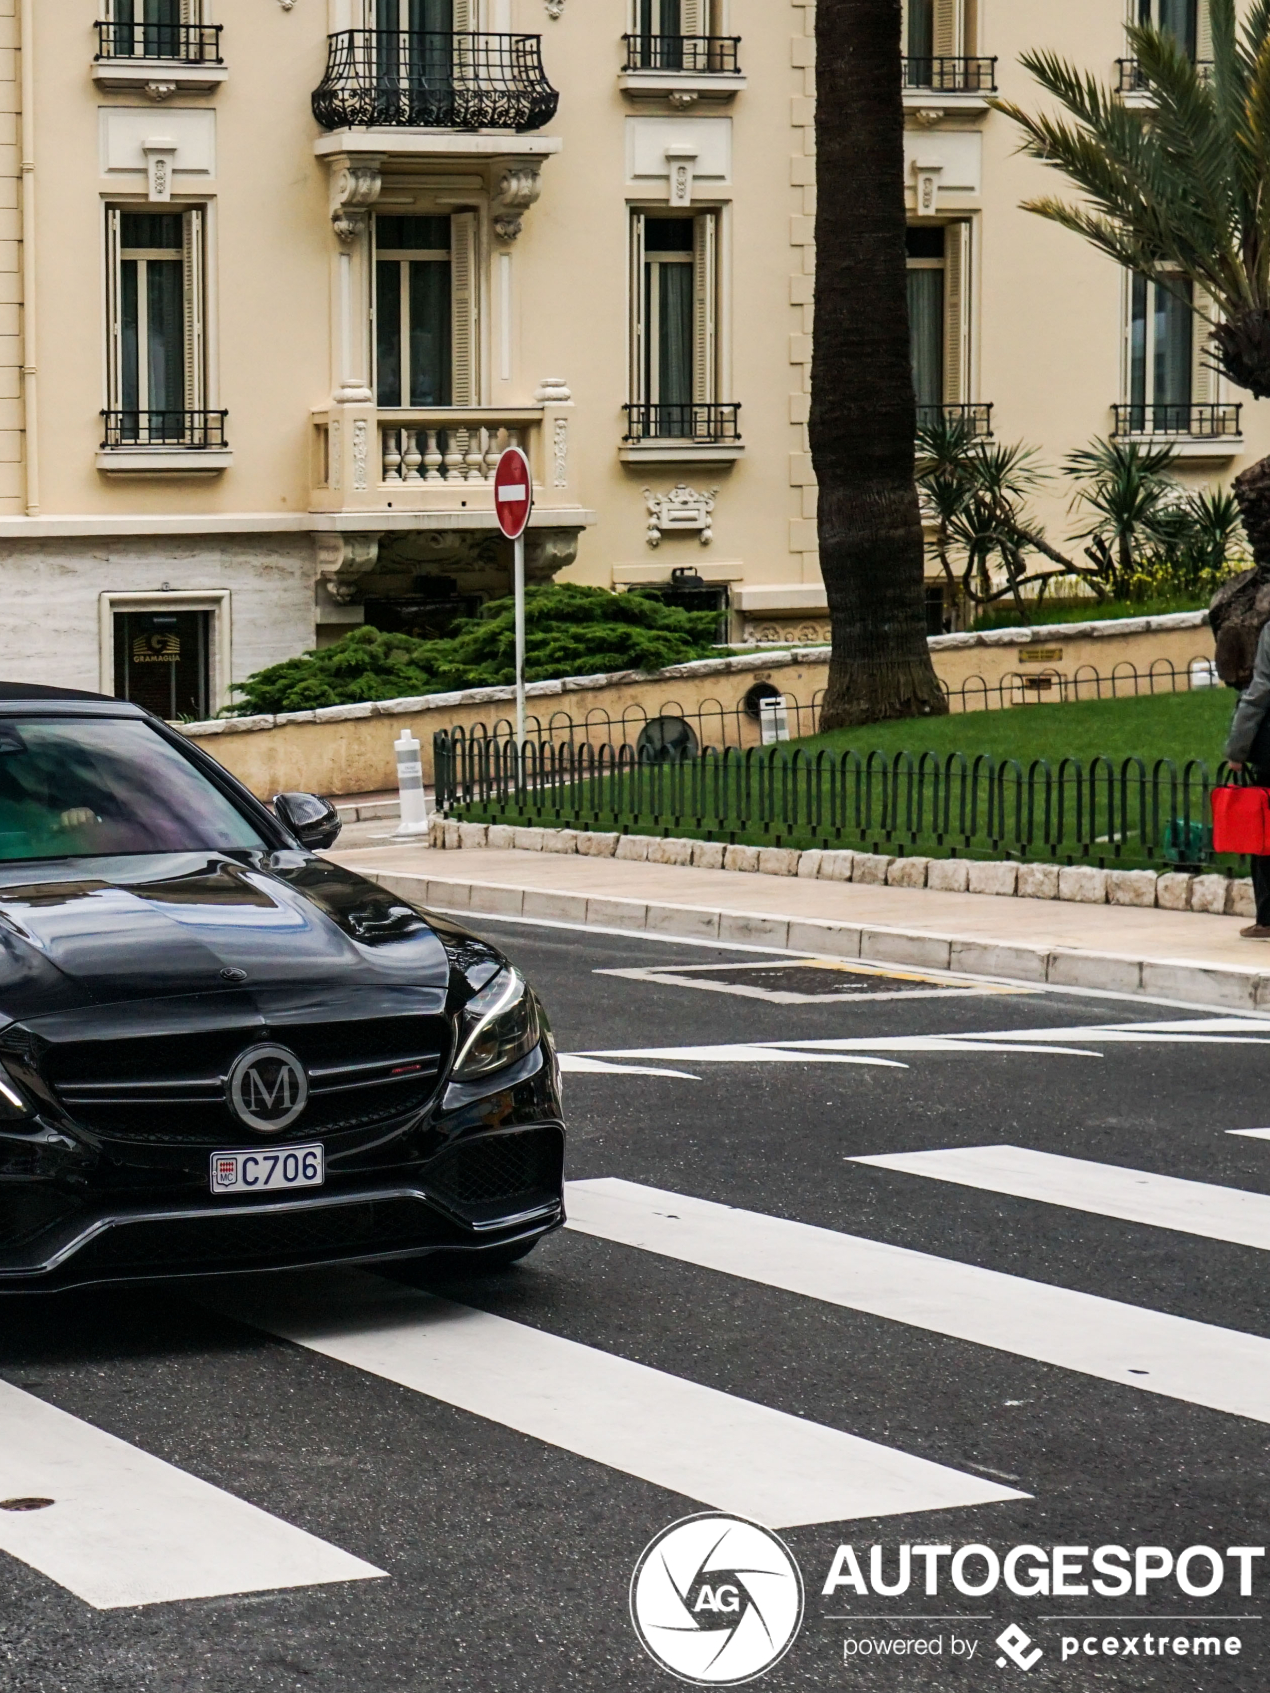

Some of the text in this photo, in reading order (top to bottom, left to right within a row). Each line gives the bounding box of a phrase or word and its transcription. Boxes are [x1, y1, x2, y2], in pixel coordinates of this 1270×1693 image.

[133, 654, 180, 663] GRAMAGLIA
[242, 1151, 318, 1186] C706
[220, 1172, 234, 1182] MC
